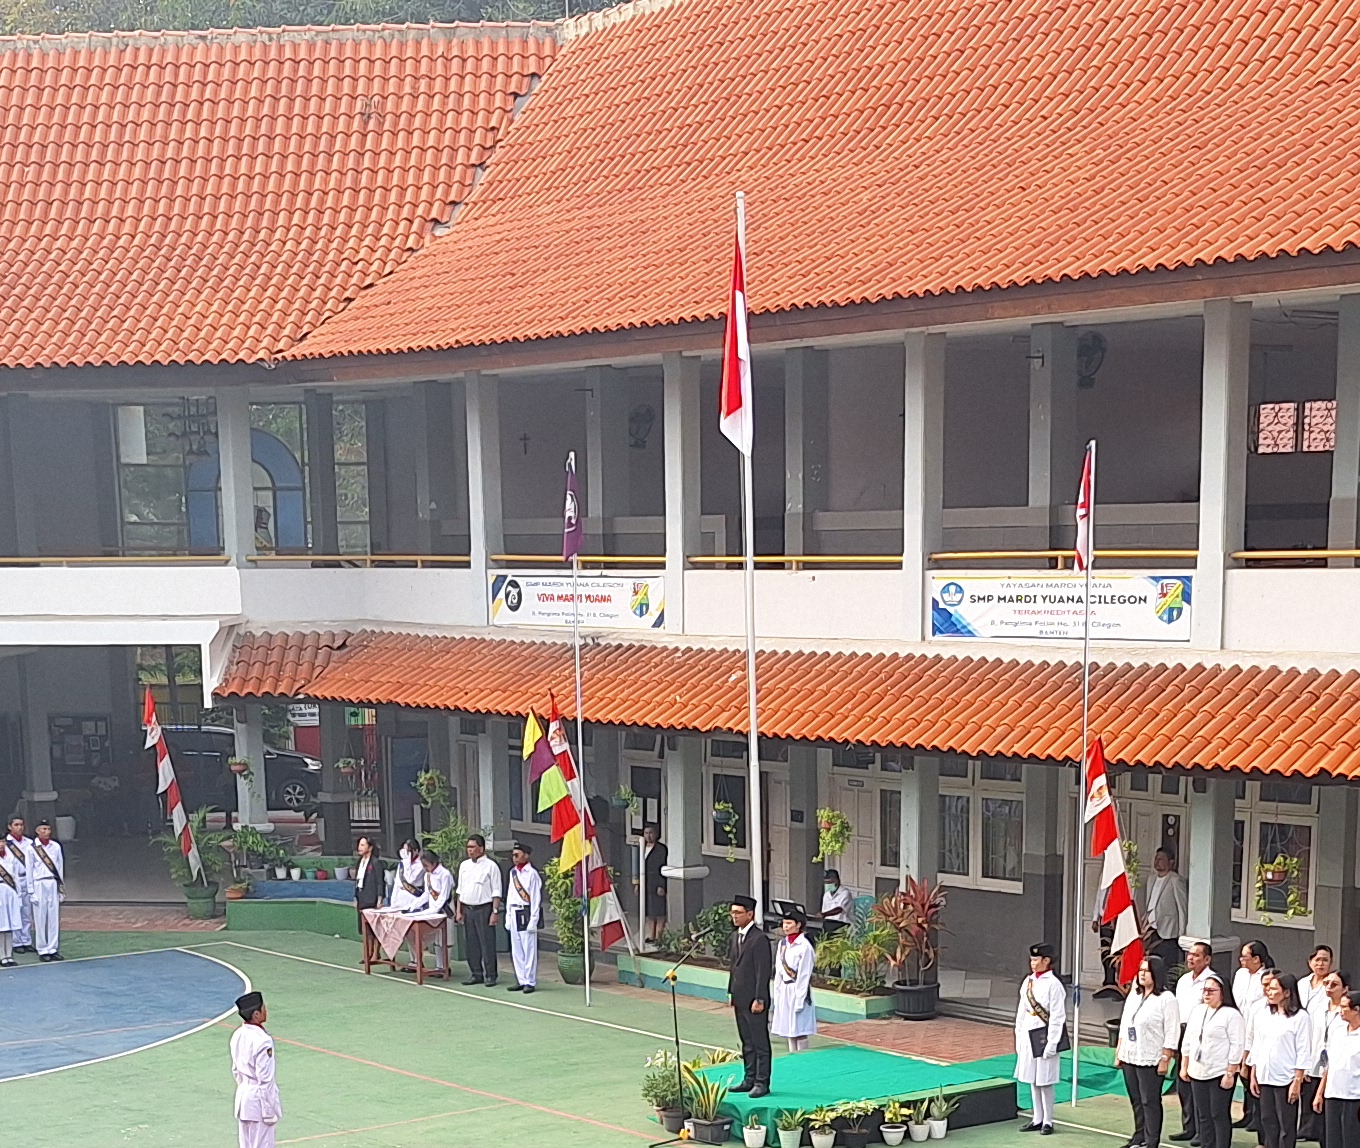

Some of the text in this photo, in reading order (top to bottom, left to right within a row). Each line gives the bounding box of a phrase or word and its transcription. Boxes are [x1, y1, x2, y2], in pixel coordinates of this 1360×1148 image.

[536, 593, 555, 603] VIVA
[584, 594, 612, 604] YUANA
[969, 594, 1148, 605] SMP MARDI YUANA CILEGON
[1091, 621, 1122, 629] Cilegon
